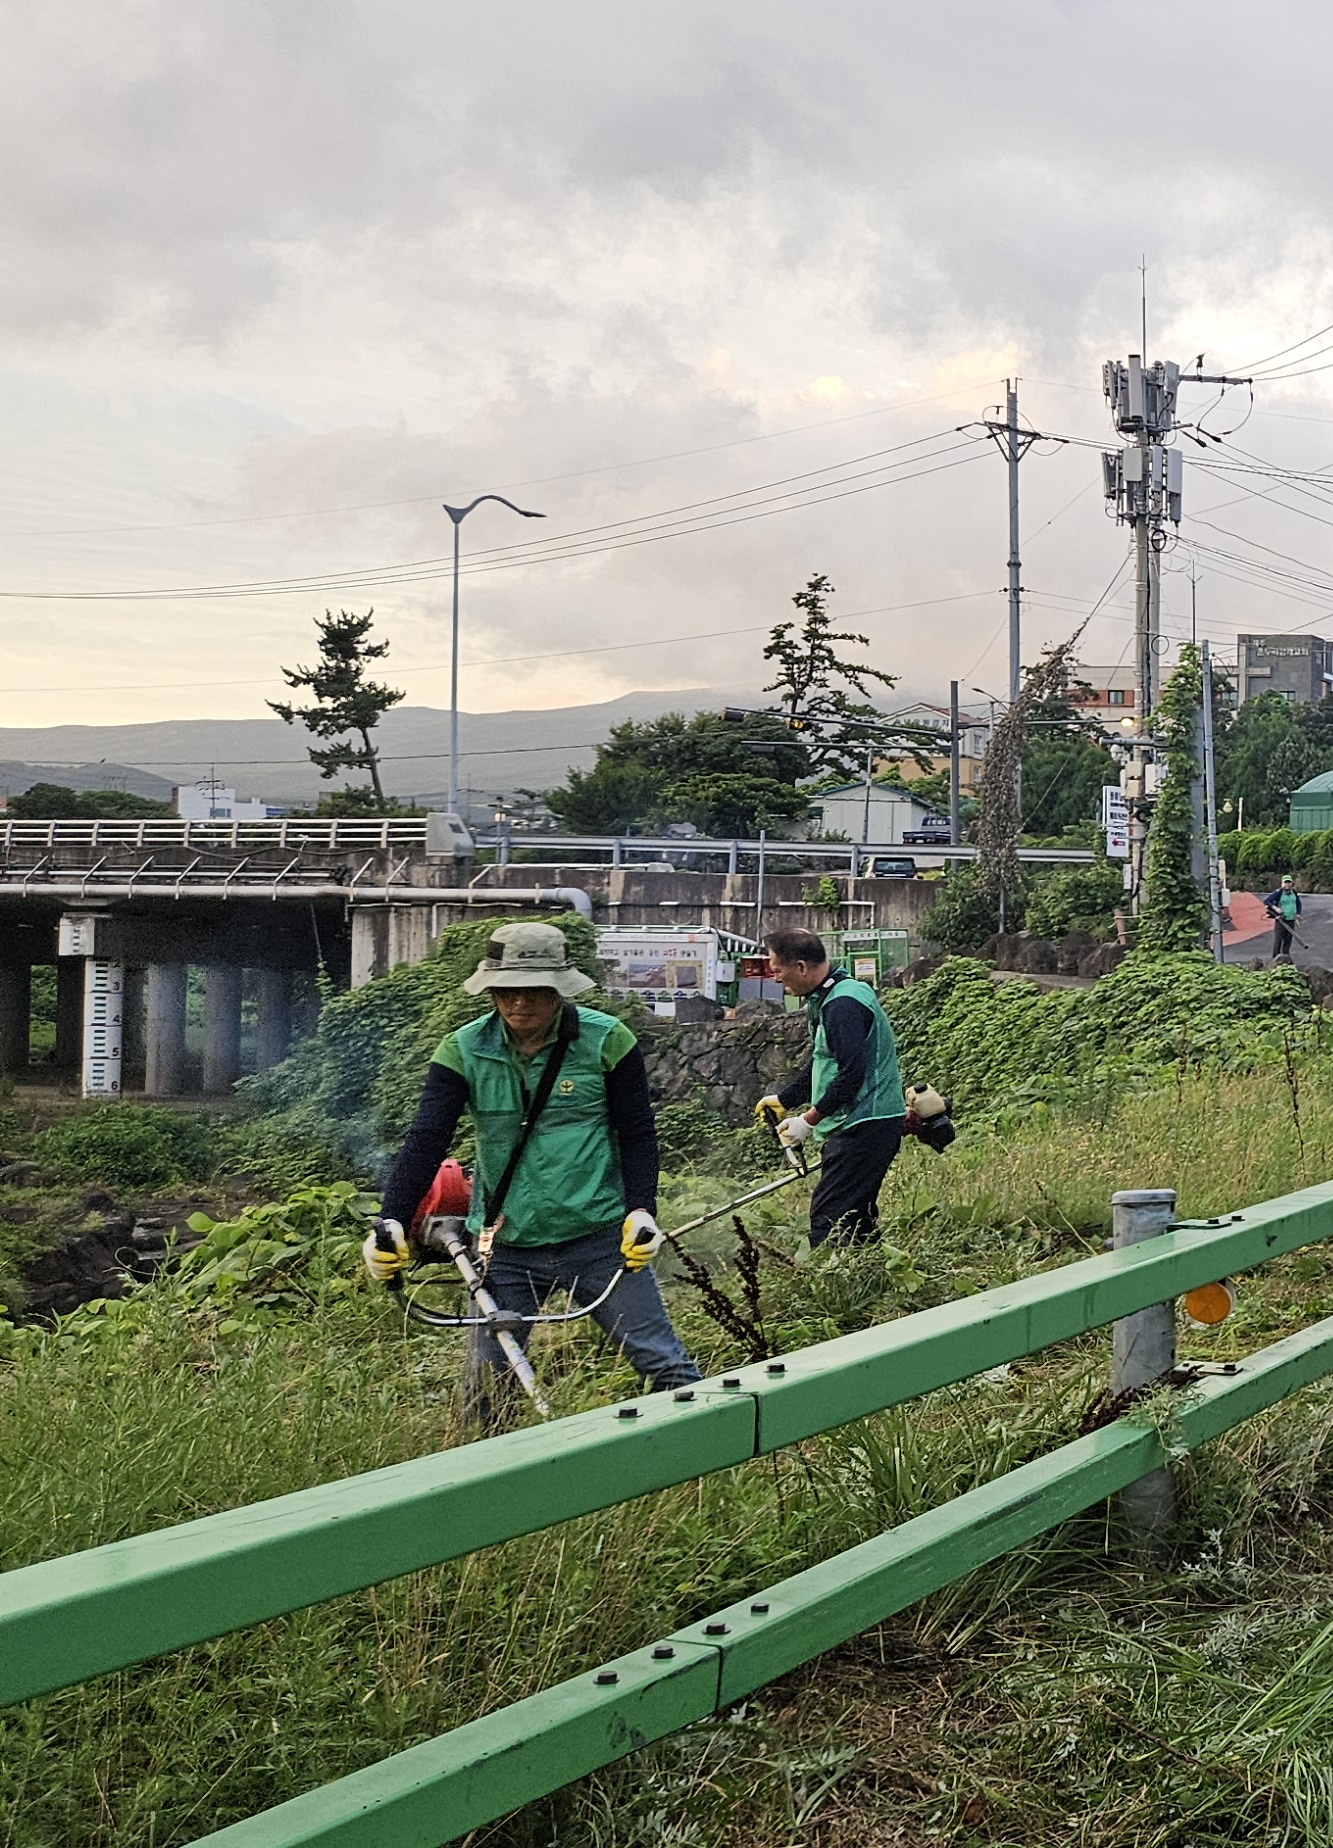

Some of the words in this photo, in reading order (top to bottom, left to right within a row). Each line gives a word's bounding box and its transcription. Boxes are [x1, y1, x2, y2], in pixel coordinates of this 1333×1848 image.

[113, 982, 120, 991] 3
[113, 1014, 121, 1023] 4
[112, 1047, 119, 1056] 5
[111, 1081, 118, 1090] 6
